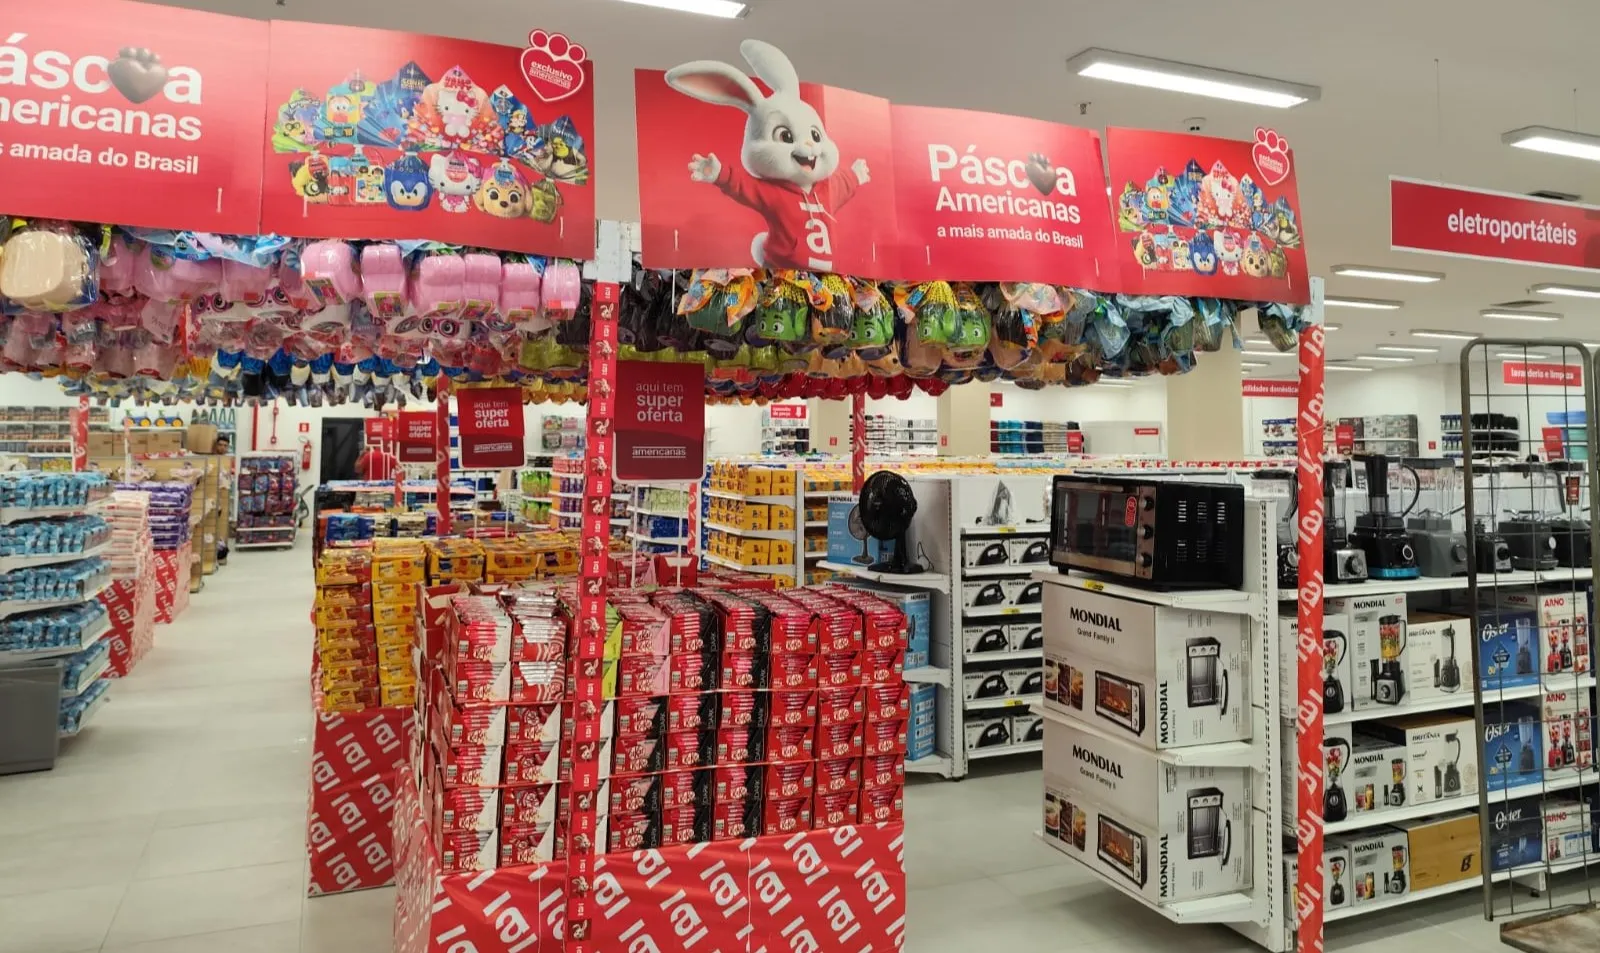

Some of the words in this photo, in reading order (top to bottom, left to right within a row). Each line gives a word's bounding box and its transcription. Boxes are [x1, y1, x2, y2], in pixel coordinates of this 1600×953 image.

[531, 61, 573, 81] exclusivo
[9, 143, 92, 164] amada
[98, 147, 129, 167] do
[134, 151, 199, 175] Brasil
[935, 186, 1081, 224] Americanas
[1447, 208, 1577, 246] eletroportáteis
[937, 226, 946, 238] a
[949, 224, 984, 239] mais
[987, 226, 1033, 242] amada
[1035, 228, 1050, 244] do
[1053, 231, 1083, 249] Brasil
[1511, 367, 1544, 378] lavaderia
[1550, 370, 1574, 381] limpza
[636, 381, 660, 394] aqui
[663, 383, 684, 392] tem
[474, 401, 492, 409] aqui
[637, 395, 683, 410] super
[475, 408, 509, 421] super
[637, 407, 683, 422] oferta
[475, 418, 509, 429] oferta
[632, 447, 686, 457] americanas
[1353, 599, 1386, 610] MONDIAL
[1544, 598, 1565, 608] ARNO
[1070, 607, 1123, 632] MONDIAL
[1076, 628, 1092, 638] Grand
[1093, 631, 1110, 645] Family
[1546, 692, 1567, 702] ARNO
[1159, 681, 1169, 744] MONDIAL
[1073, 745, 1124, 779] MONDIAL
[1354, 754, 1384, 765] MONDIAL
[1080, 767, 1095, 780] Grand
[1096, 774, 1113, 790] Family
[1354, 841, 1385, 854] MONDIAL
[1160, 834, 1169, 898] MONDIAL
